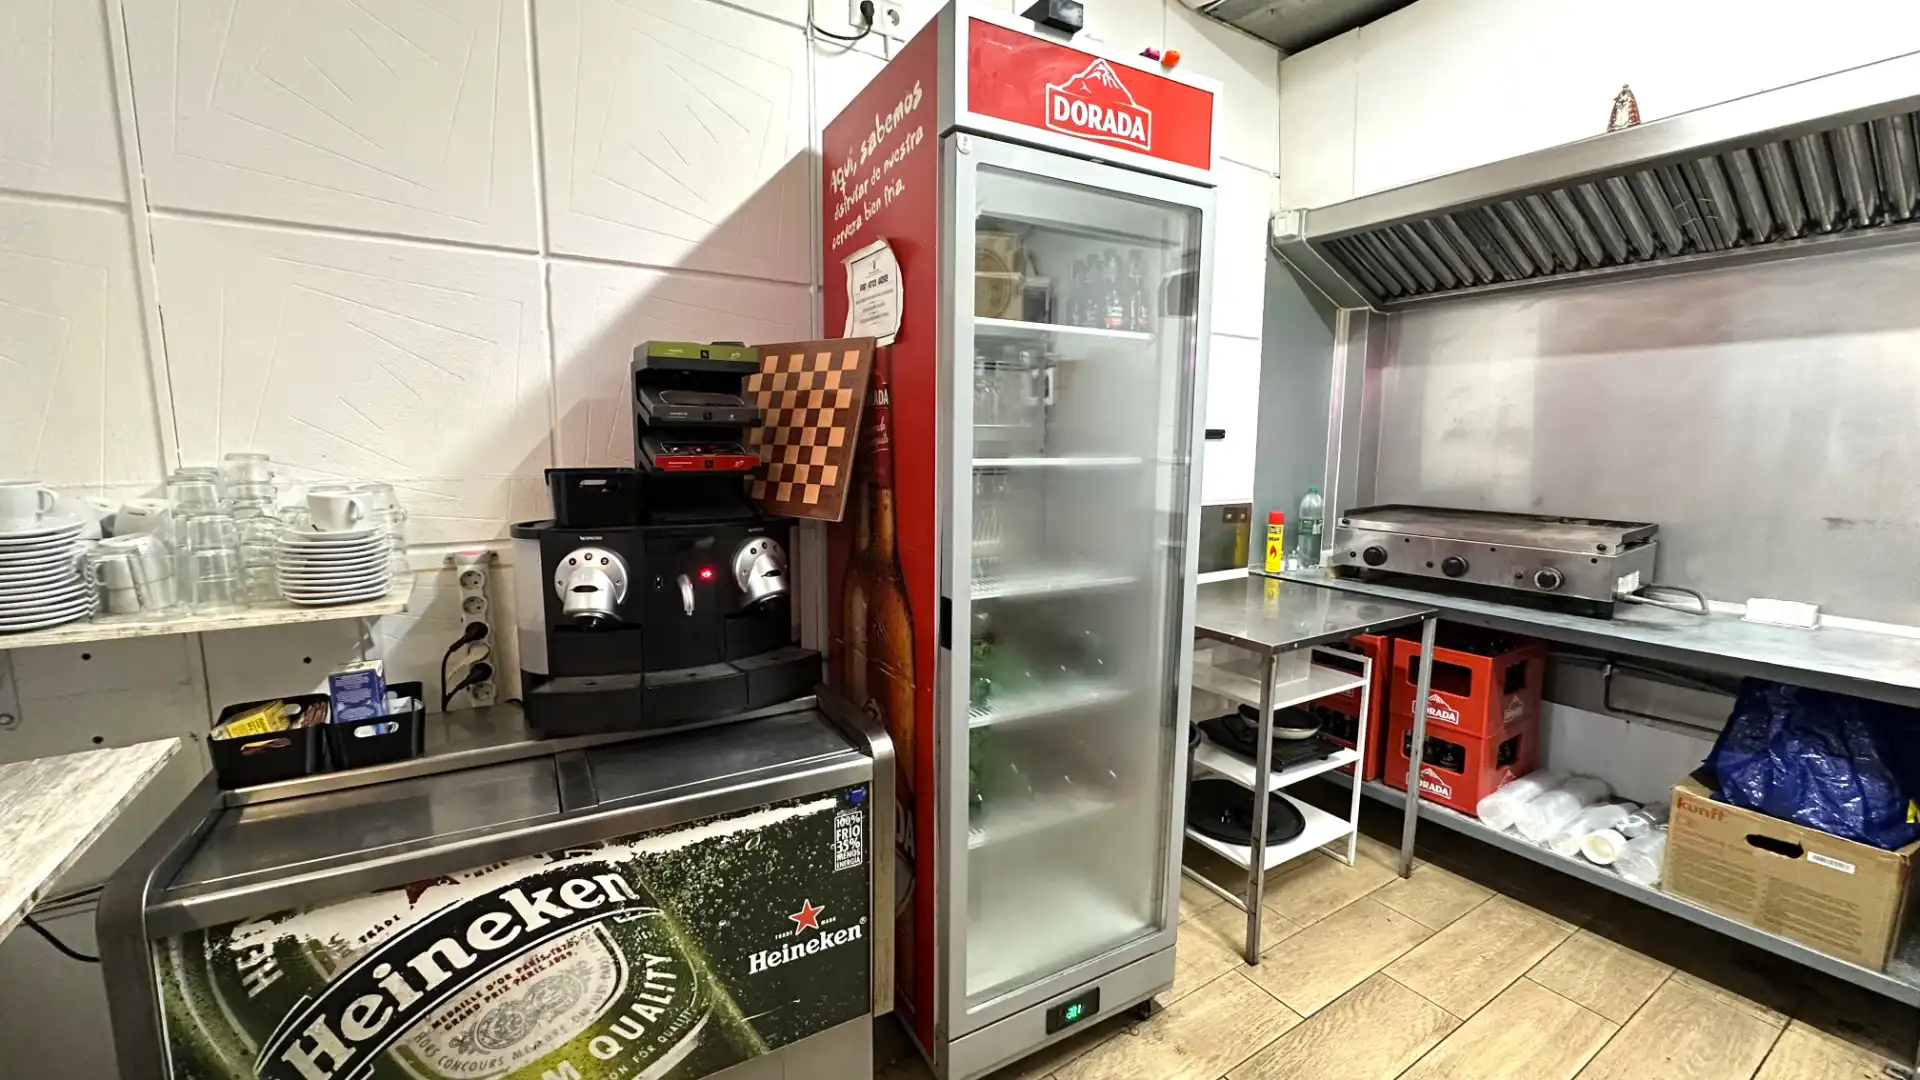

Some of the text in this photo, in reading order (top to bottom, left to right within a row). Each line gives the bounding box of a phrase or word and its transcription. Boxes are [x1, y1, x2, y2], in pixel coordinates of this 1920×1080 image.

[860, 79, 922, 165] sabemos
[1053, 94, 1146, 142] DORADA
[834, 125, 924, 221] disfrutar de nuestra
[832, 214, 862, 250] cerveza
[863, 198, 881, 221] bien
[836, 813, 861, 828] 100%
[1677, 797, 1723, 821] kunft
[836, 837, 861, 854] 35%
[836, 848, 861, 862] MENOS
[748, 924, 862, 975] Heineken
[281, 872, 641, 1080] Heineken
[431, 990, 483, 1030] MEDAILLE
[485, 972, 513, 992] D'OR
[444, 1002, 481, 1031] GRAND
[485, 985, 511, 1004] PRIX
[512, 965, 546, 987] PARIS
[588, 952, 677, 1060] QUALITY
[414, 1031, 437, 1058] HORS
[437, 1055, 505, 1072] CONCOURS
[632, 1045, 657, 1064] FOR
[657, 1006, 695, 1044] QUALITY
